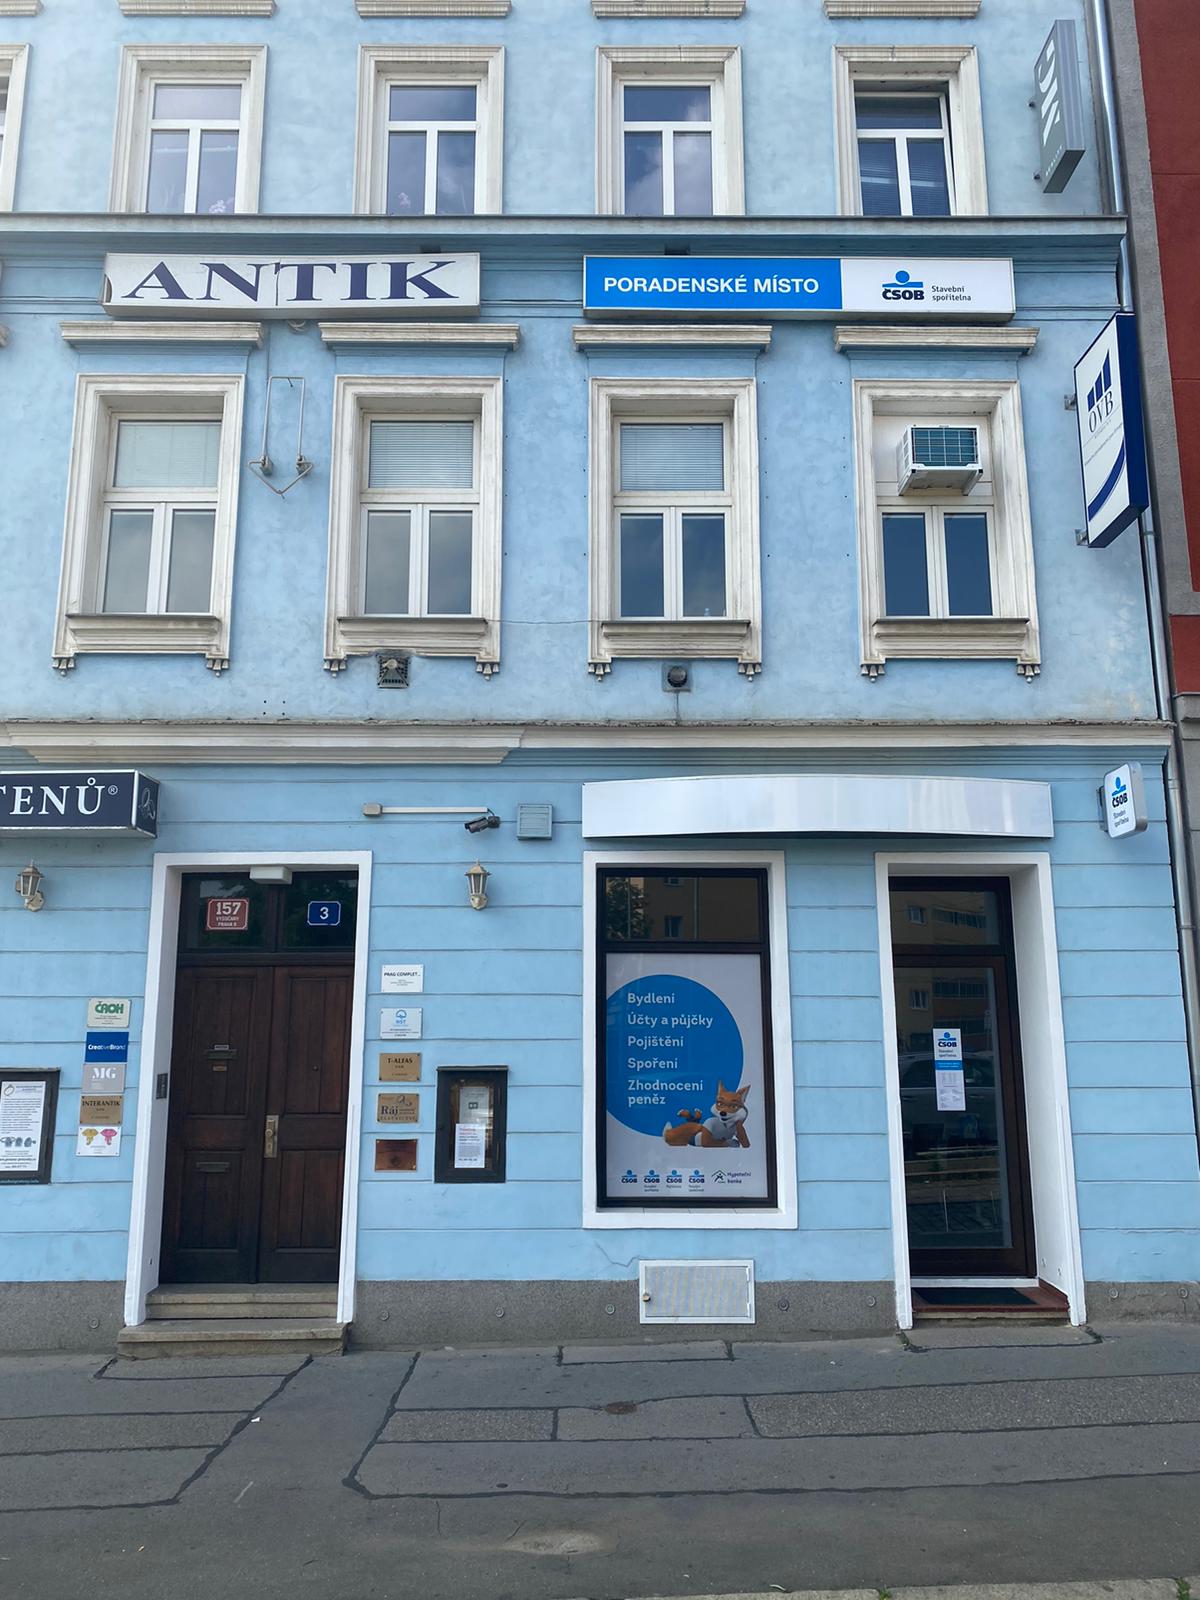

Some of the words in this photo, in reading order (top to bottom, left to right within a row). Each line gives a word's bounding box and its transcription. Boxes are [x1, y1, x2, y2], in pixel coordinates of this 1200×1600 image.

[121, 260, 460, 302] ANTIK
[603, 274, 747, 293] PORADENSKÉ
[753, 274, 819, 294] MÍSTO
[882, 288, 925, 301] ČSOB
[931, 285, 965, 293] Stavební
[932, 293, 972, 302] spořitelna
[1088, 390, 1114, 433] OVB
[1111, 792, 1128, 808] ČSOB
[216, 902, 241, 915] 157
[319, 906, 329, 920] 3
[627, 992, 675, 1007] Bydlení
[627, 1011, 658, 1028] Účty
[661, 1016, 669, 1025] a
[671, 1013, 713, 1028] půjčky
[627, 1036, 684, 1050] Pojištění
[627, 1057, 678, 1072] Spoření
[628, 1079, 703, 1091] Zhodnocení
[628, 1093, 666, 1108] peněz
[621, 1176, 638, 1184] ČSOB
[644, 1176, 660, 1184] ČSOB
[666, 1176, 682, 1184] ČSOB
[688, 1176, 705, 1184] ČSOB
